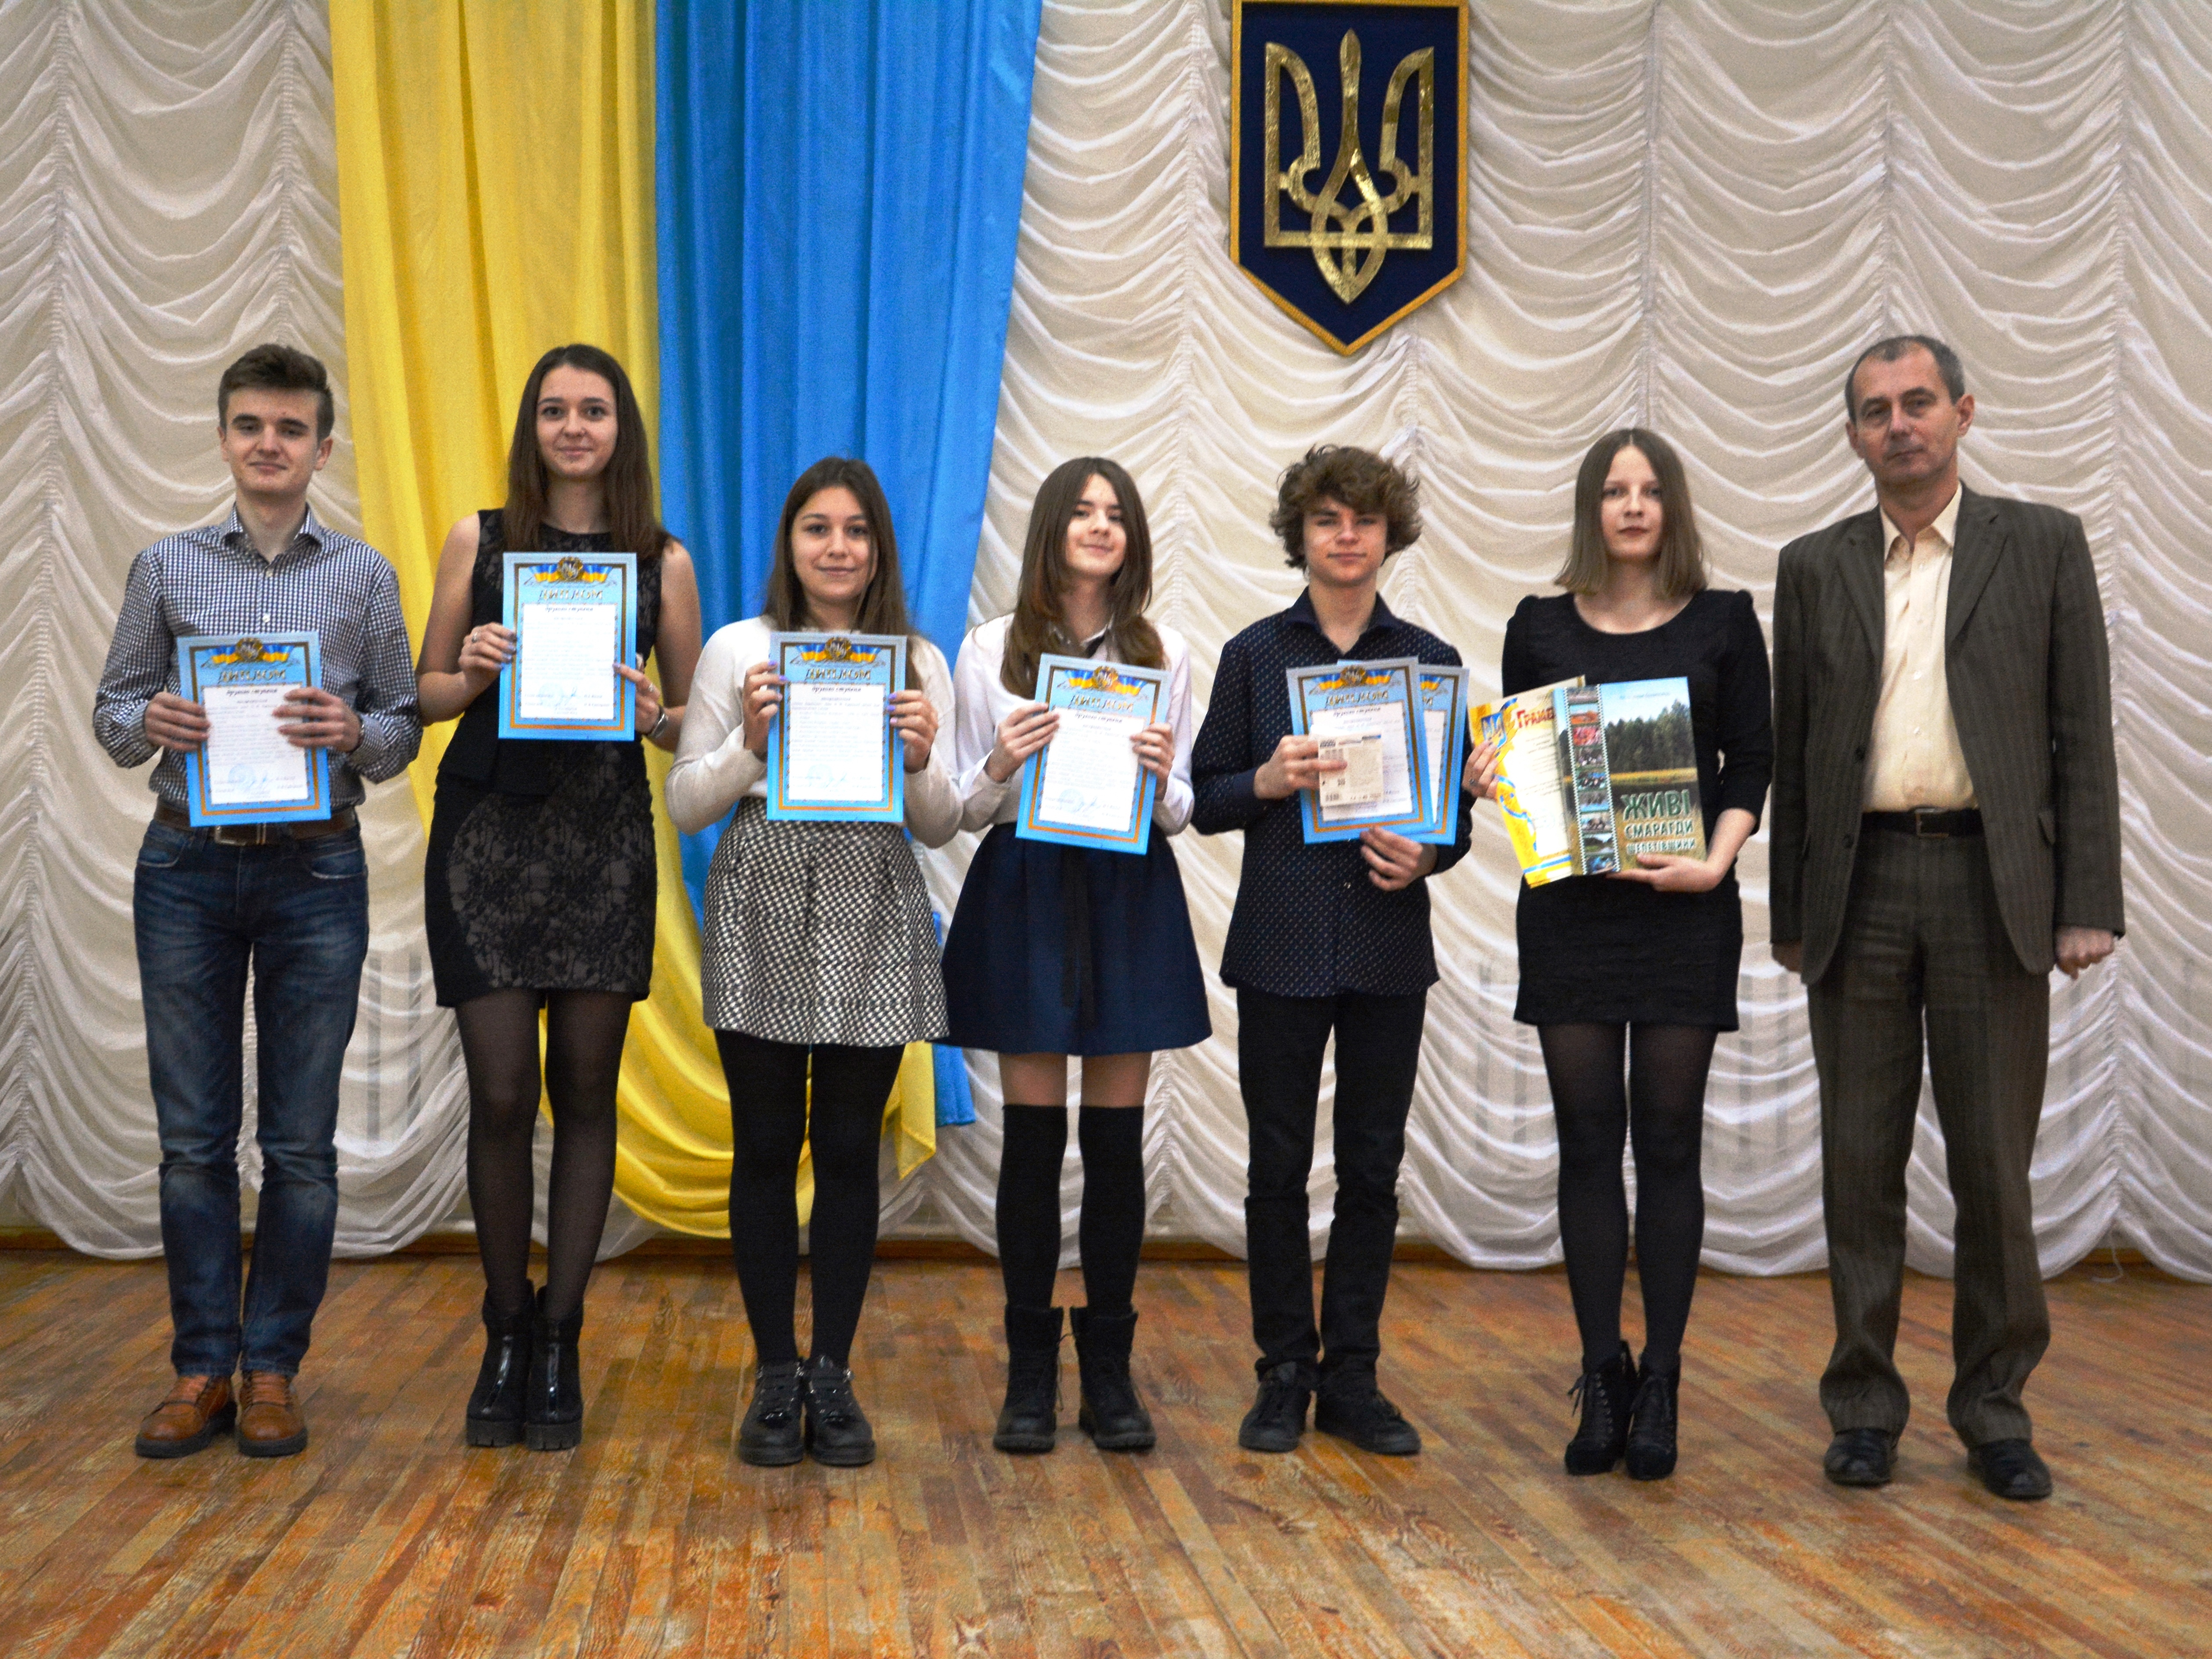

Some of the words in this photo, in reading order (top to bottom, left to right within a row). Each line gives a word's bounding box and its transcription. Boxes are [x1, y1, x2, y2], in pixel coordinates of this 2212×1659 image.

[537, 589, 603, 601] ДИПЛОМ
[218, 669, 286, 683] ДИПЛОМ
[805, 668, 871, 681] ДИПЛОМ
[1068, 695, 1134, 712] ДИПЛОМ
[1325, 690, 1388, 708] ДИПЛОМ
[1517, 706, 1555, 728] ГРАМО
[1621, 789, 1690, 821] ЖИВІ
[1624, 818, 1693, 839] СМАРАГДИ
